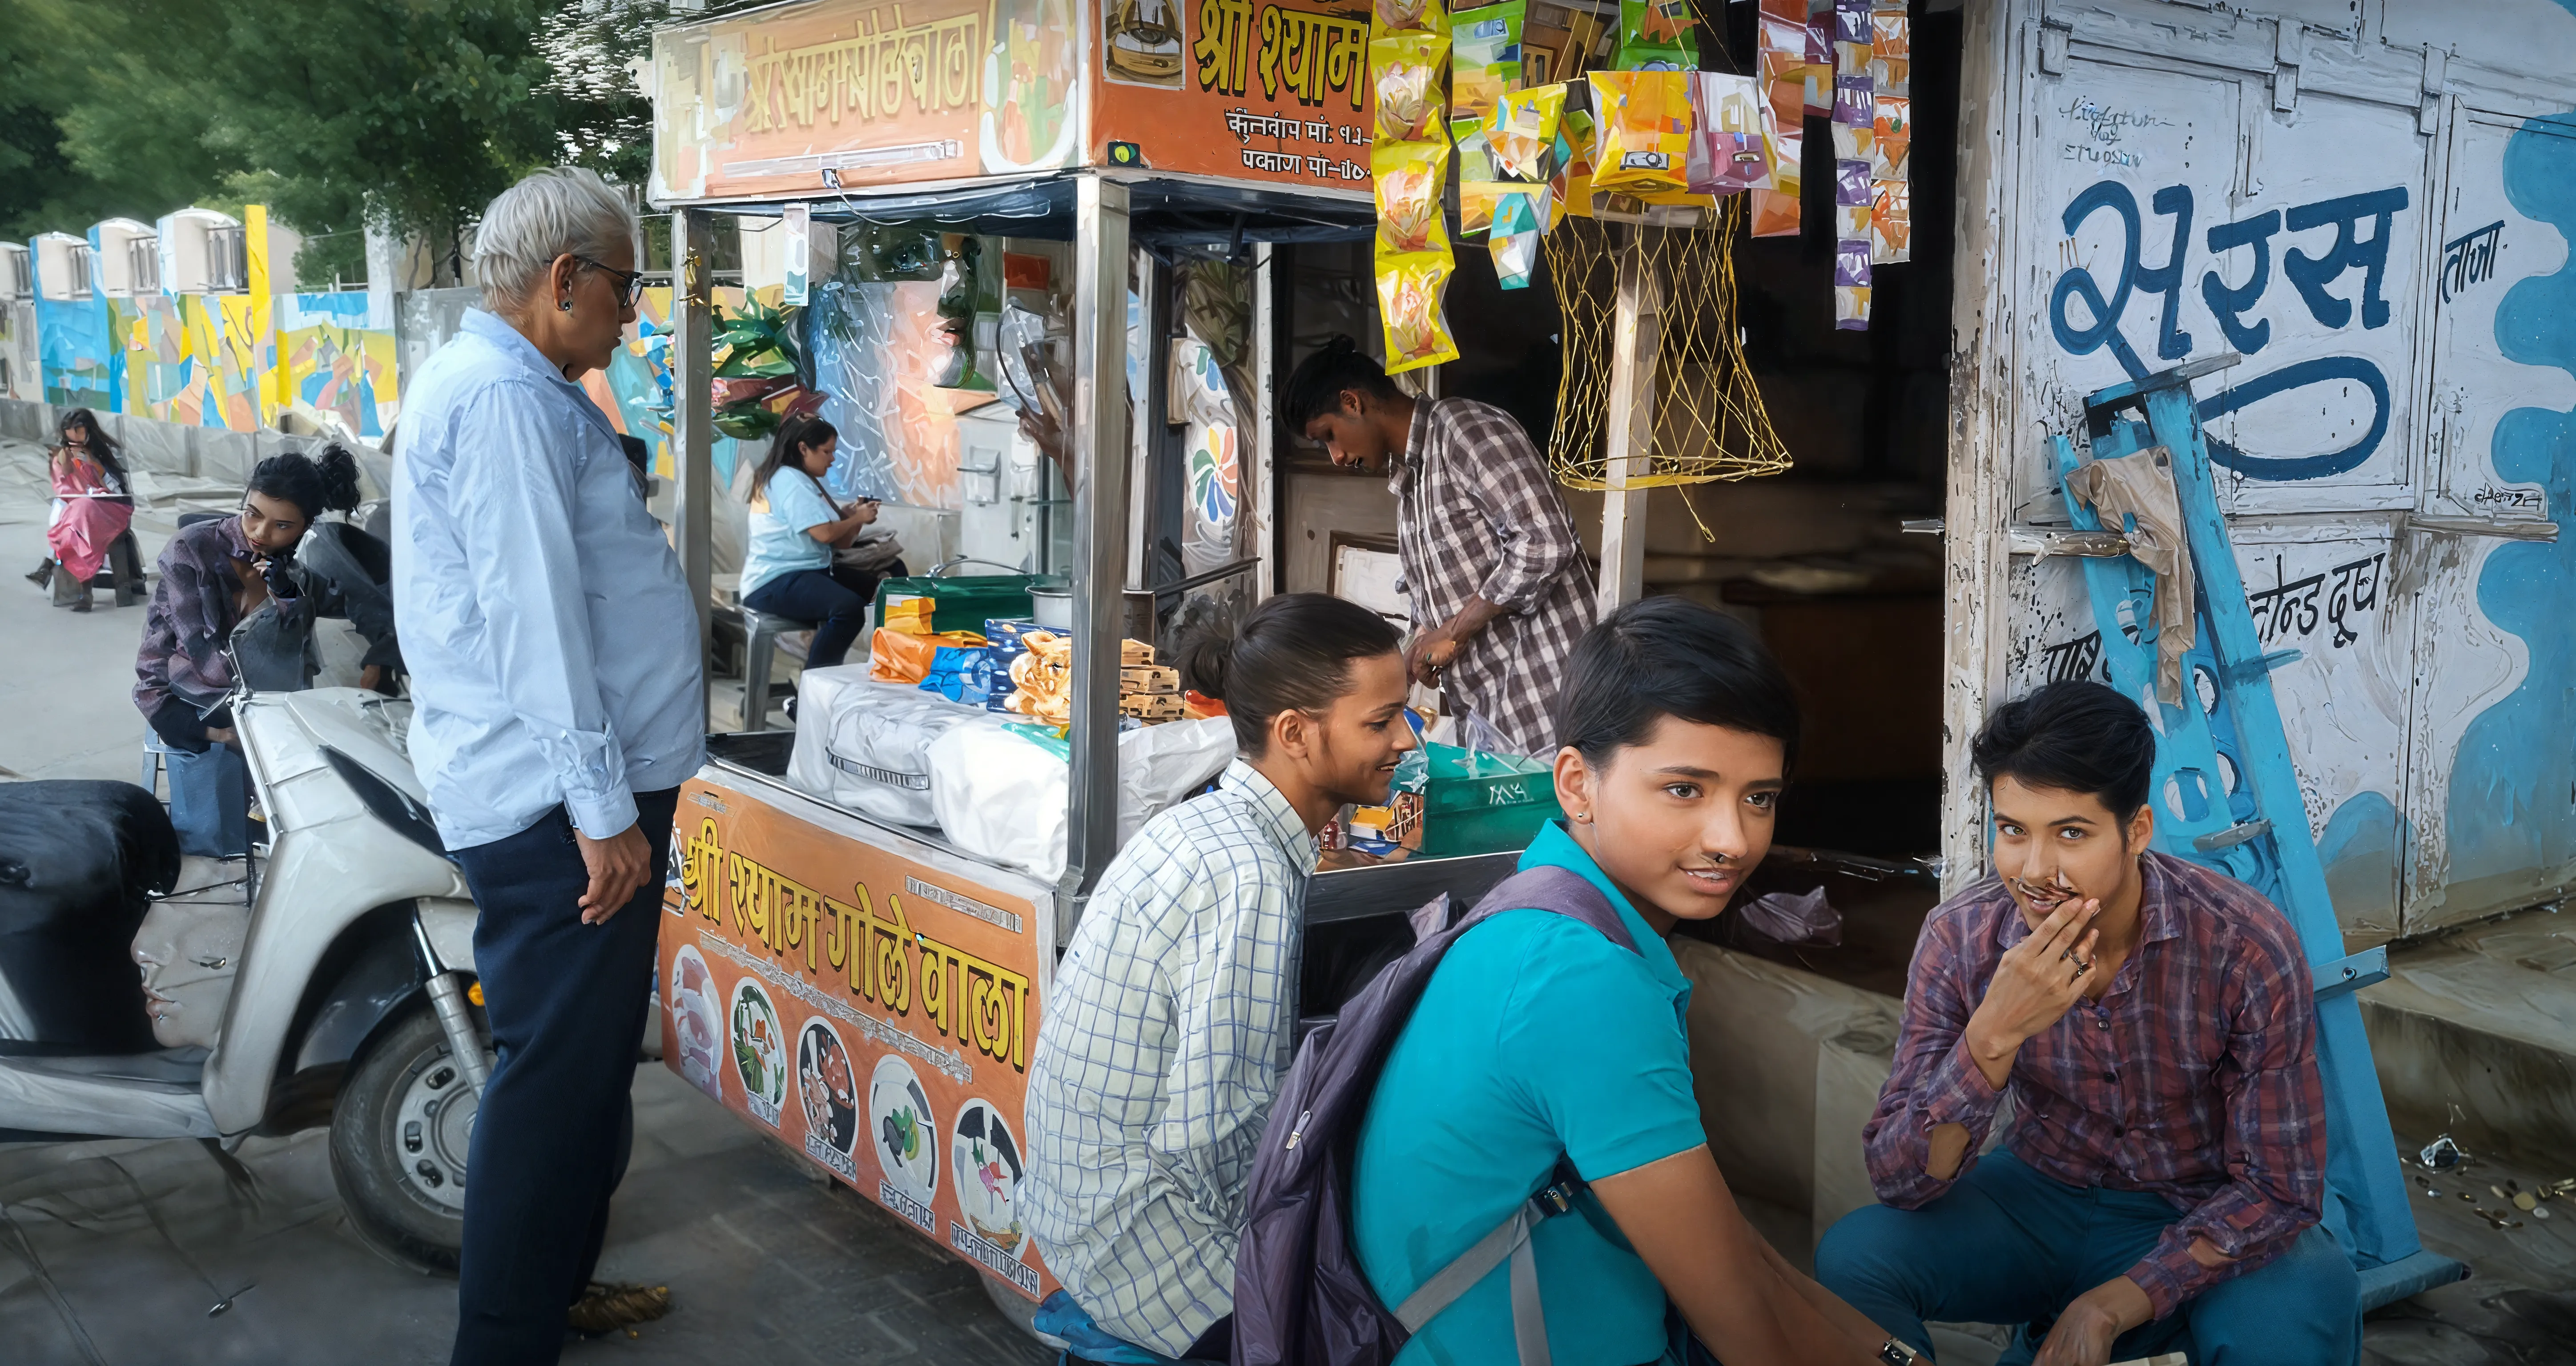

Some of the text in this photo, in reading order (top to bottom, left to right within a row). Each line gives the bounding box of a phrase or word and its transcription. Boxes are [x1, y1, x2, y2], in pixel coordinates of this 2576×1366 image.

[1258, 4, 1370, 112] श्याम
[729, 850, 820, 975] श्याम
[824, 881, 914, 1016] गोले
[919, 935, 1029, 1073] वाला
